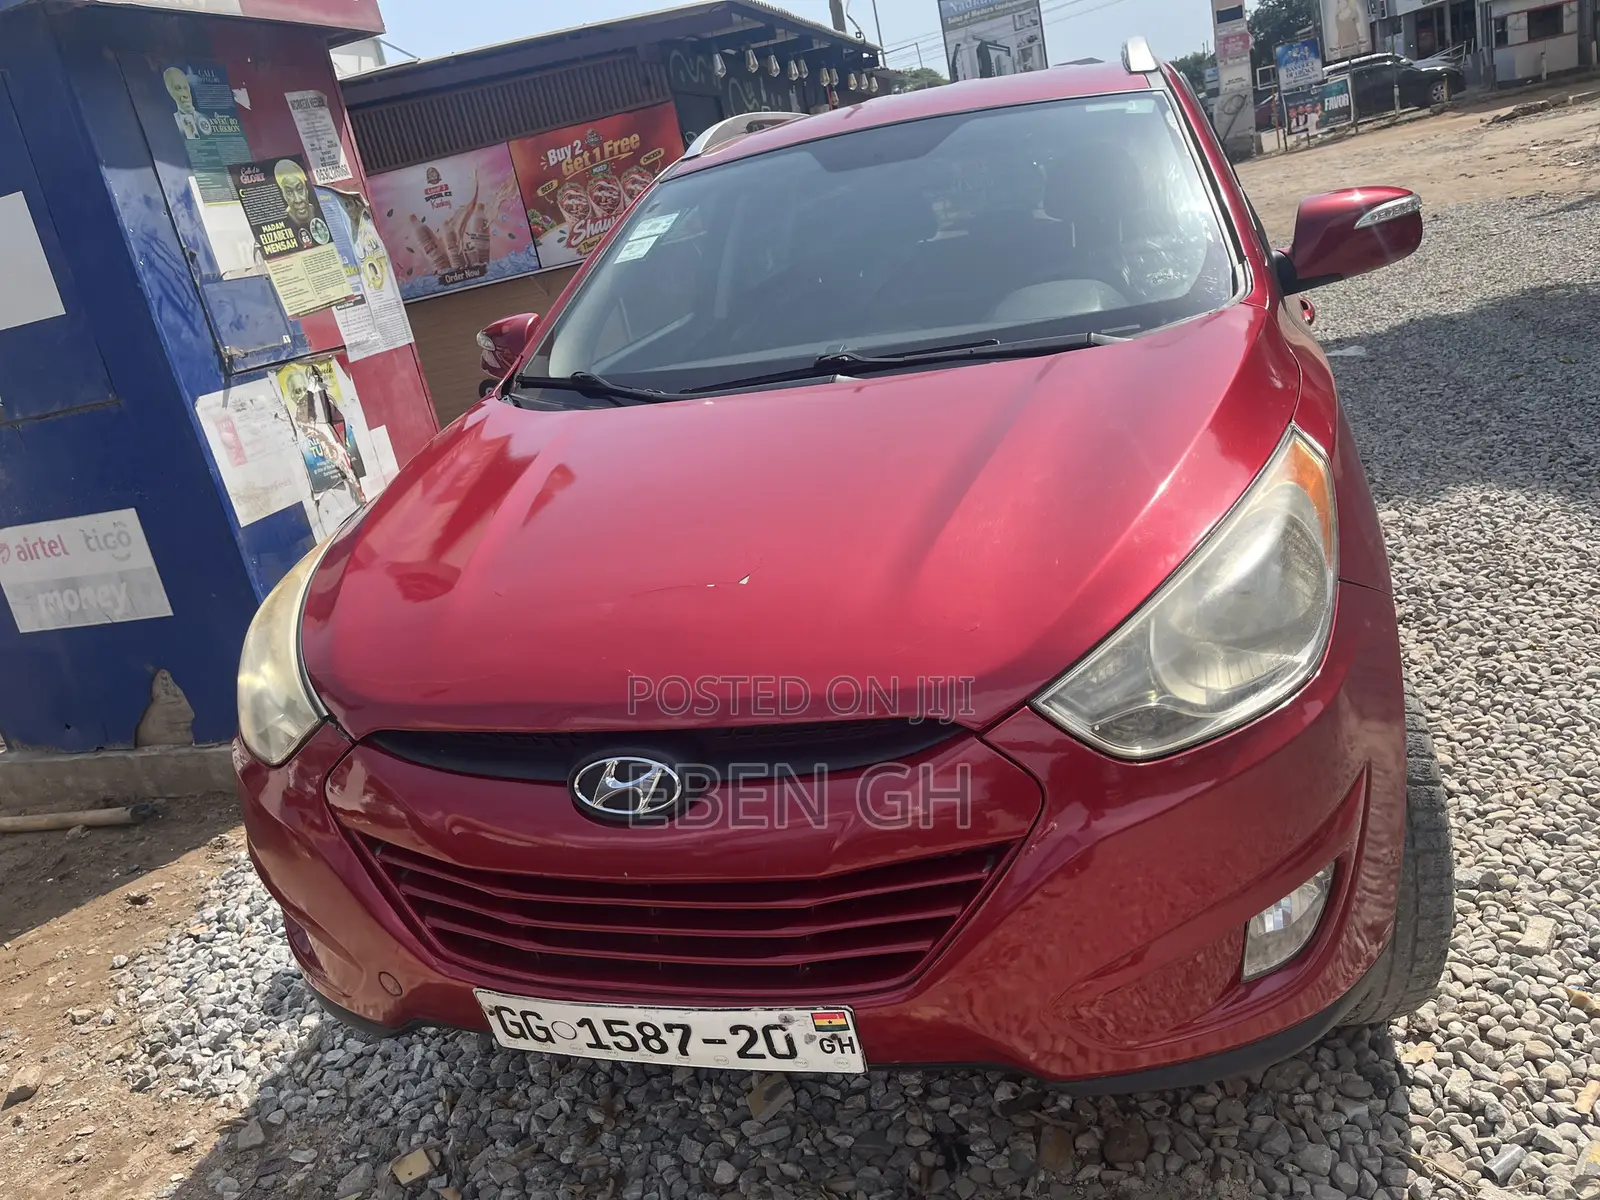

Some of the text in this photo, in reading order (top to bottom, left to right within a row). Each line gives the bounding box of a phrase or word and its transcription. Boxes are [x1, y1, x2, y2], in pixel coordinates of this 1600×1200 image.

[1324, 93, 1349, 111] FAVOR
[547, 143, 572, 167] Buy
[573, 139, 583, 154] 2
[561, 150, 592, 177] Get
[592, 146, 602, 162] 1
[603, 133, 640, 159] Free
[540, 181, 555, 194] BEEF
[259, 228, 295, 245] ELIZABETH
[261, 221, 286, 233] MADAM
[263, 239, 299, 255] MENSAH
[445, 268, 480, 283] Order Now
[15, 534, 70, 562] airtel
[37, 581, 129, 620] money
[493, 1005, 799, 1060] GG 1587-20
[819, 1035, 857, 1055] GH
